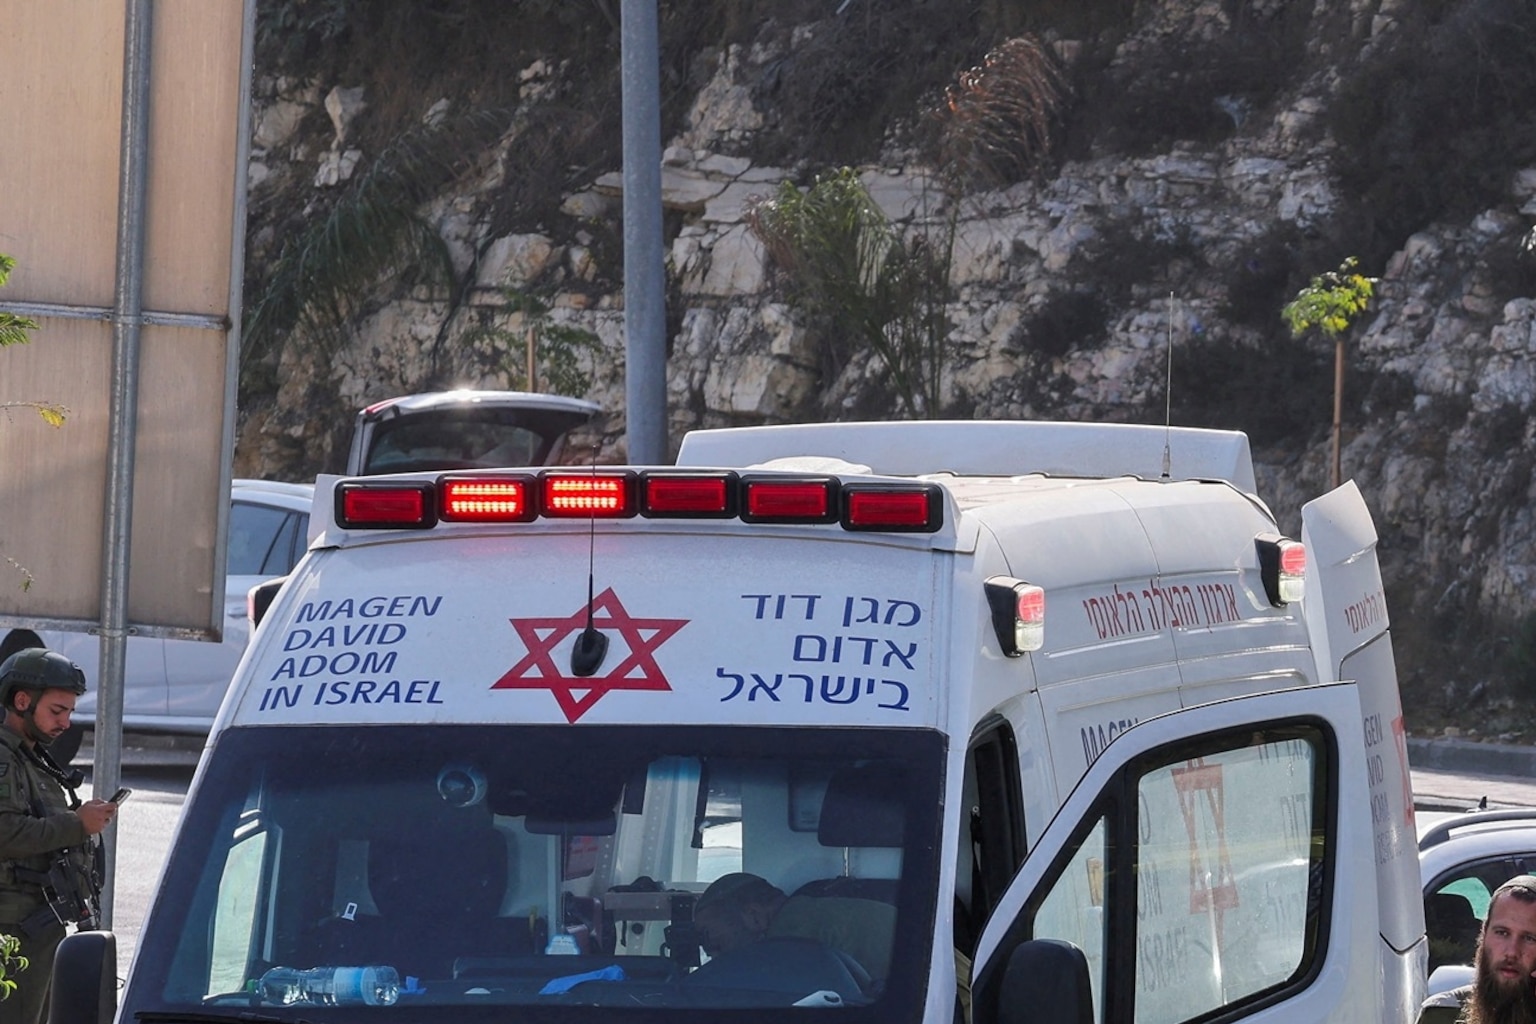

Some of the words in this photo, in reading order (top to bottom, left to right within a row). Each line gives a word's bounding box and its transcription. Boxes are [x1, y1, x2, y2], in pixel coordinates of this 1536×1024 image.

[295, 595, 443, 624] MAGEN
[741, 593, 822, 622] דוד
[843, 596, 922, 627] מגן
[1083, 584, 1145, 640] הלאומי
[1143, 578, 1200, 631] ההצלה
[1197, 583, 1241, 634] ארגון
[283, 622, 407, 652] DAVID
[793, 634, 917, 671] אדום
[271, 651, 398, 681] ADOM
[259, 684, 302, 712] IN
[313, 680, 444, 705] ISRAEL
[716, 667, 911, 711] בישראל
